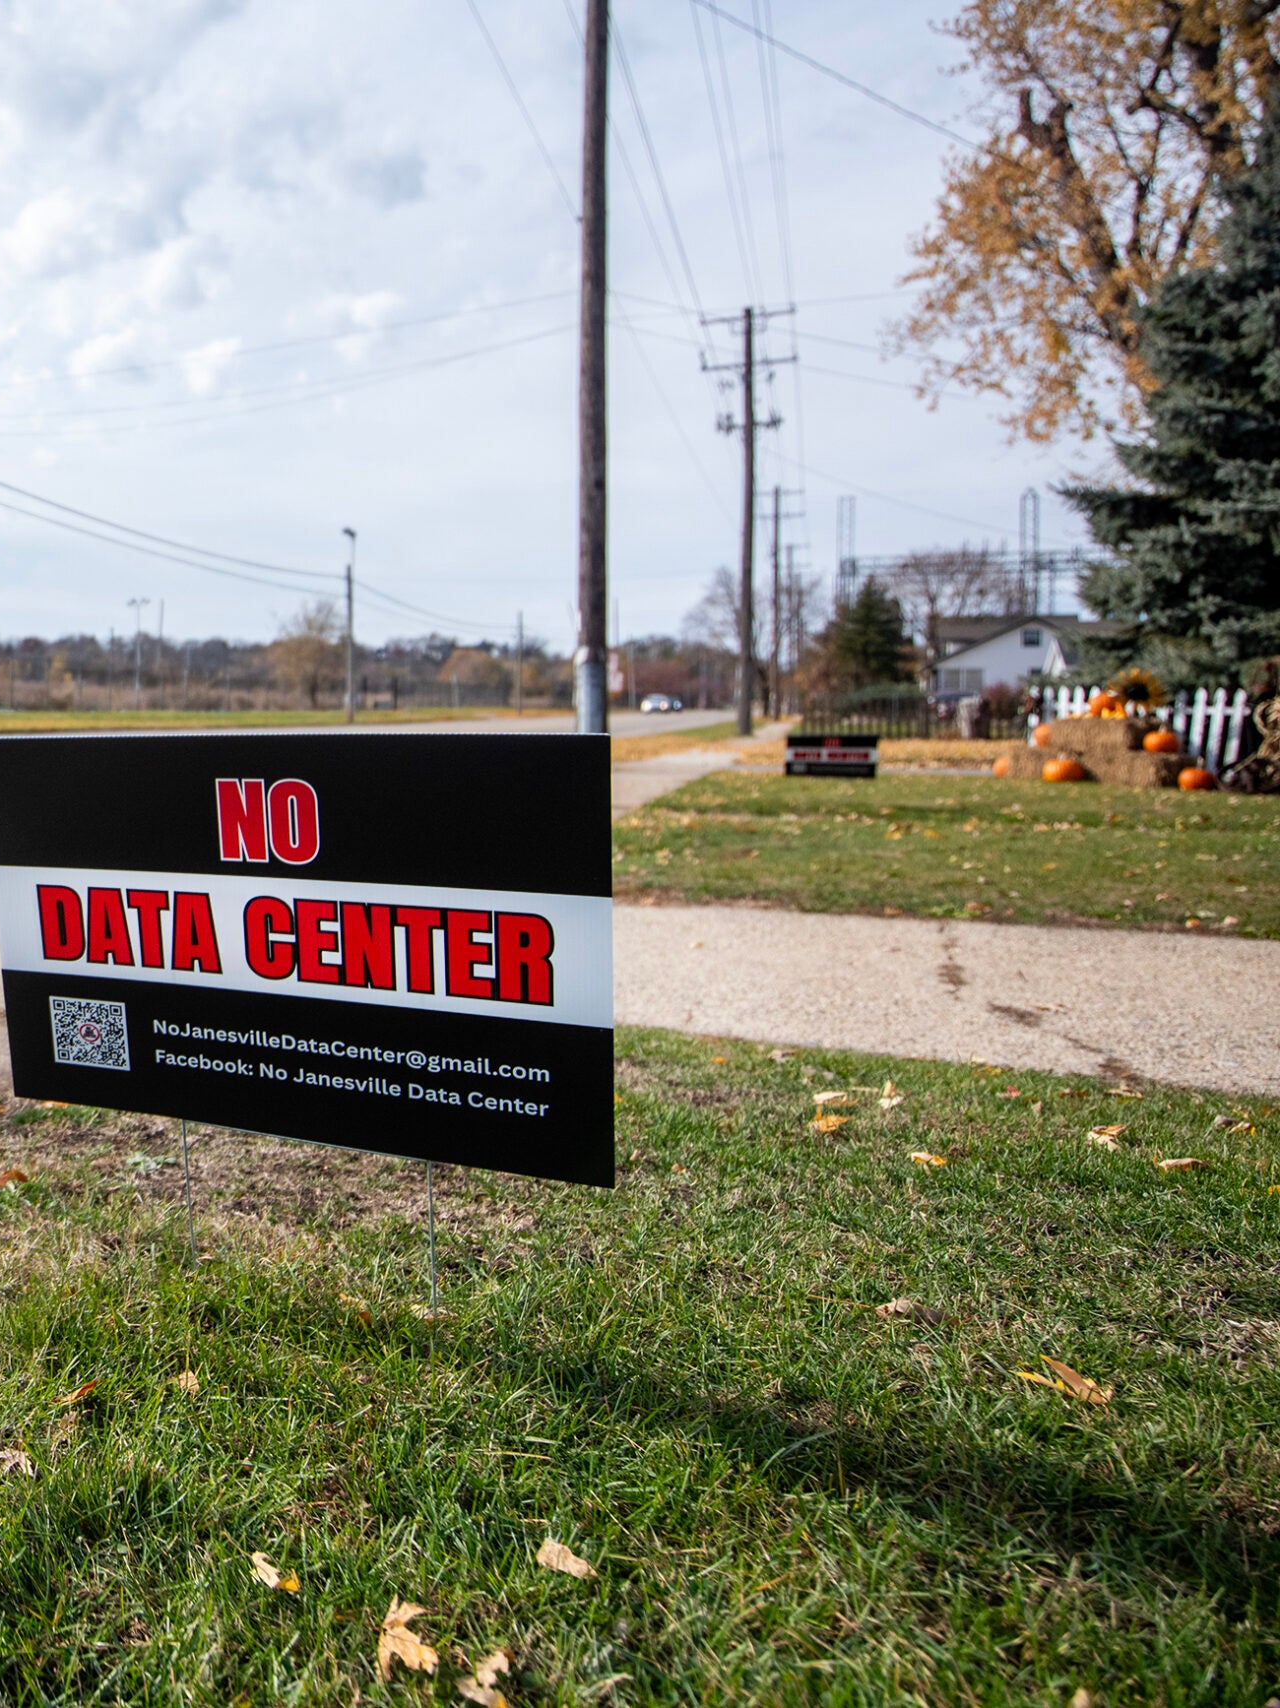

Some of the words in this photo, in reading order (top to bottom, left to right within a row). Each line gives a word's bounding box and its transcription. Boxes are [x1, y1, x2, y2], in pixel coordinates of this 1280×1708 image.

[215, 778, 320, 865] NO
[36, 883, 223, 974] DATA
[243, 895, 555, 1007] CENTER
[152, 1018, 551, 1083] NoJanesvilleDataCenter@gmail.com
[154, 1048, 254, 1076] Facebook:
[259, 1062, 288, 1081] No
[293, 1068, 402, 1097] Janesville
[408, 1083, 462, 1106] Data
[467, 1091, 550, 1117] Center
